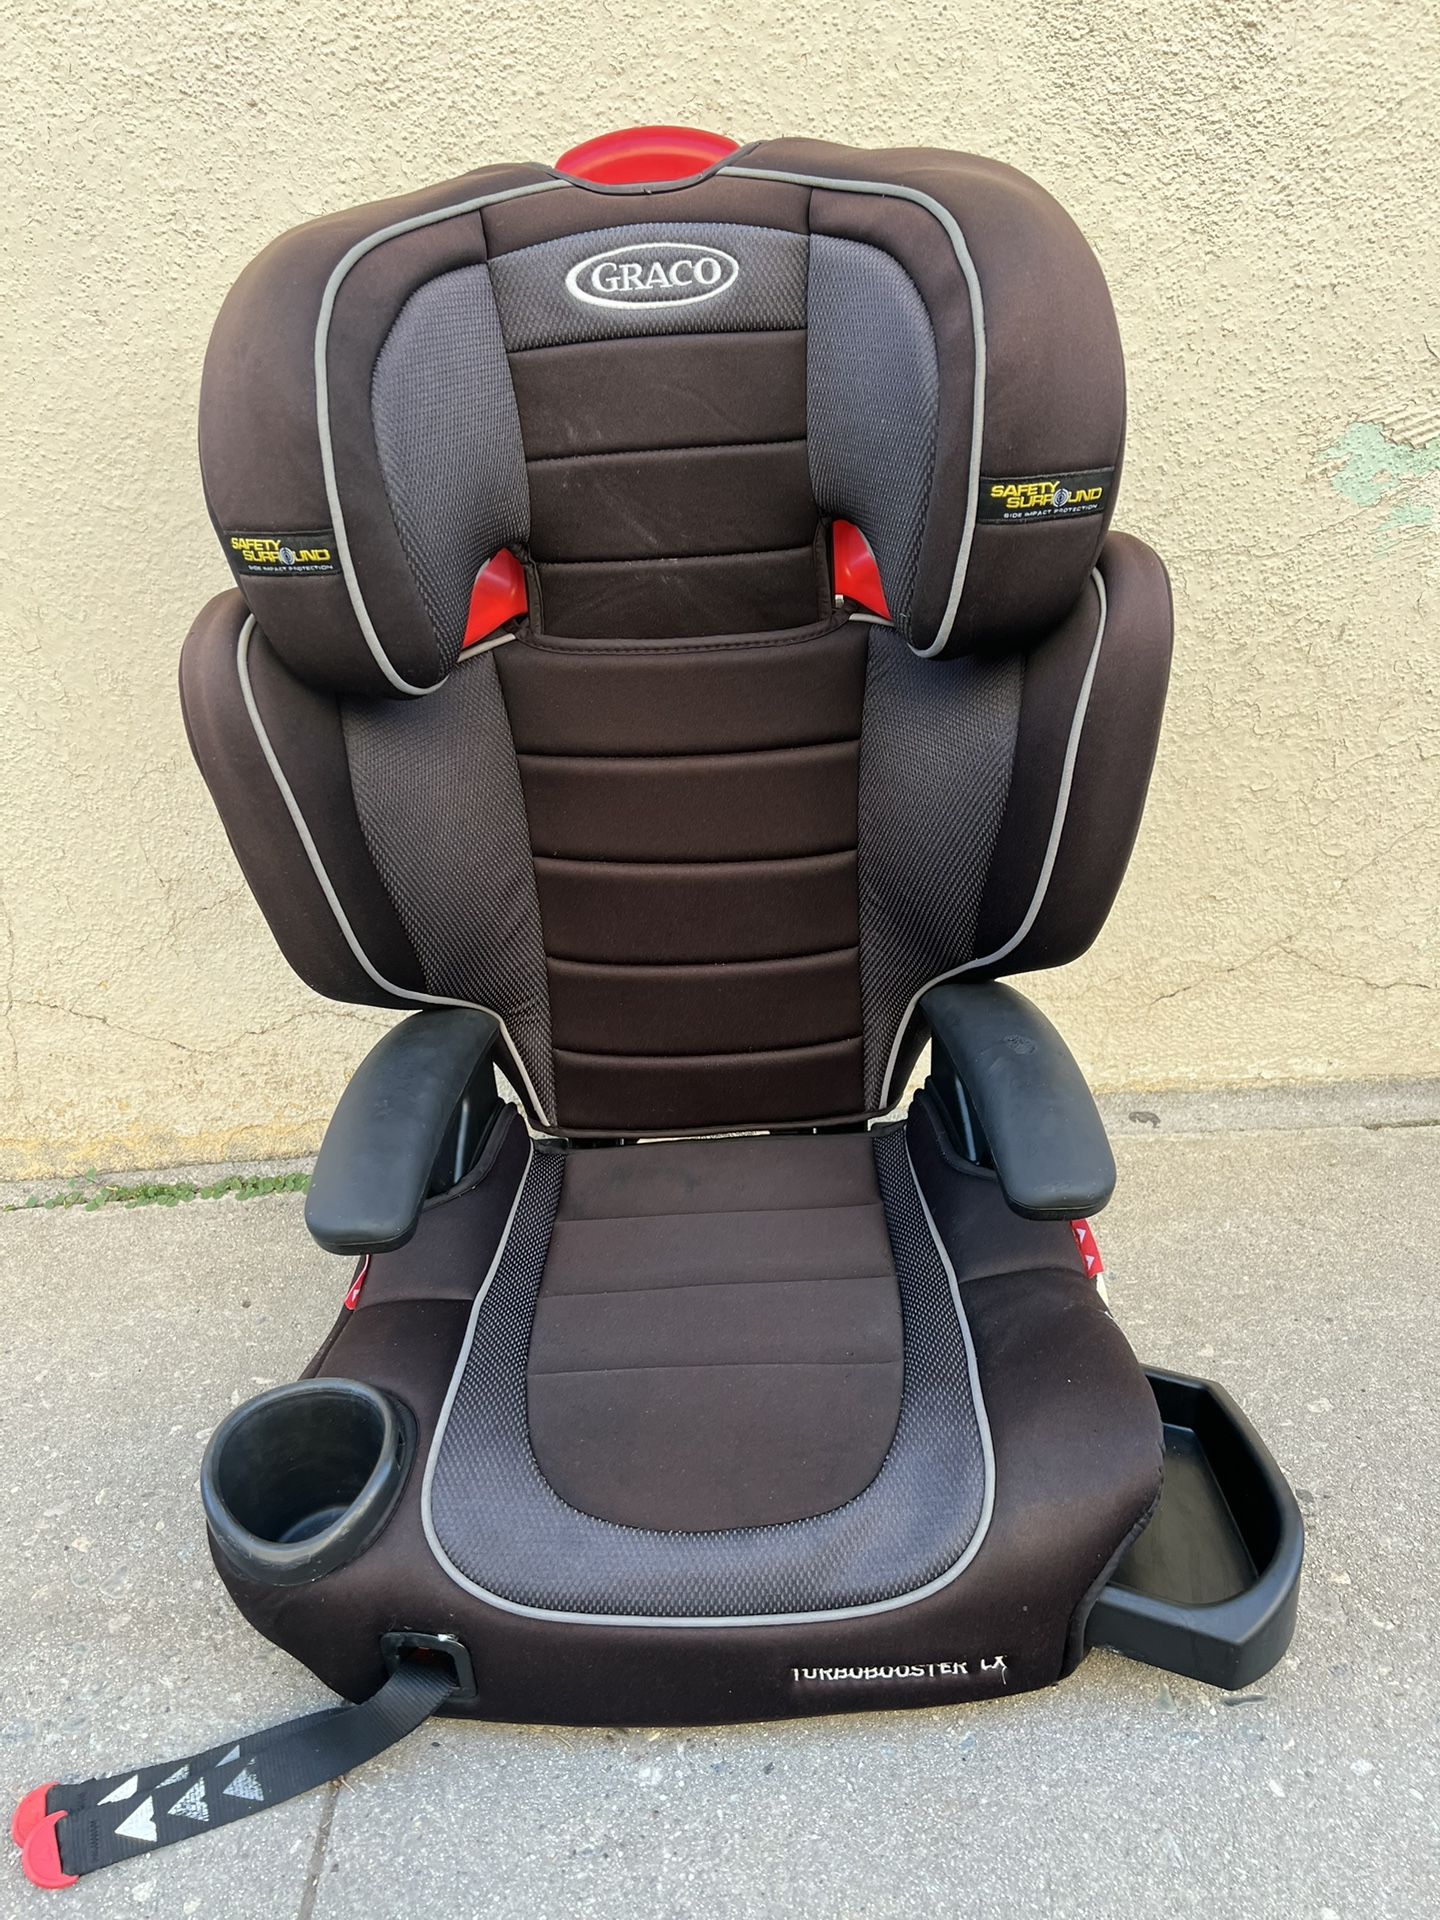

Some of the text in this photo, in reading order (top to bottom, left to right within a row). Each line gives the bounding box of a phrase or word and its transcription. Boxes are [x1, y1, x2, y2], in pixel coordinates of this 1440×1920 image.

[591, 257, 722, 293] GRACO
[990, 480, 1060, 498] SAFETY
[1006, 487, 1103, 509] SURROUND
[1024, 509, 1052, 517] IMPACT
[1053, 503, 1098, 514] PROTECTION
[230, 537, 281, 551] SAFETY
[242, 547, 331, 565] SURROUND
[791, 1661, 968, 1682] TURBOBOOSTER
